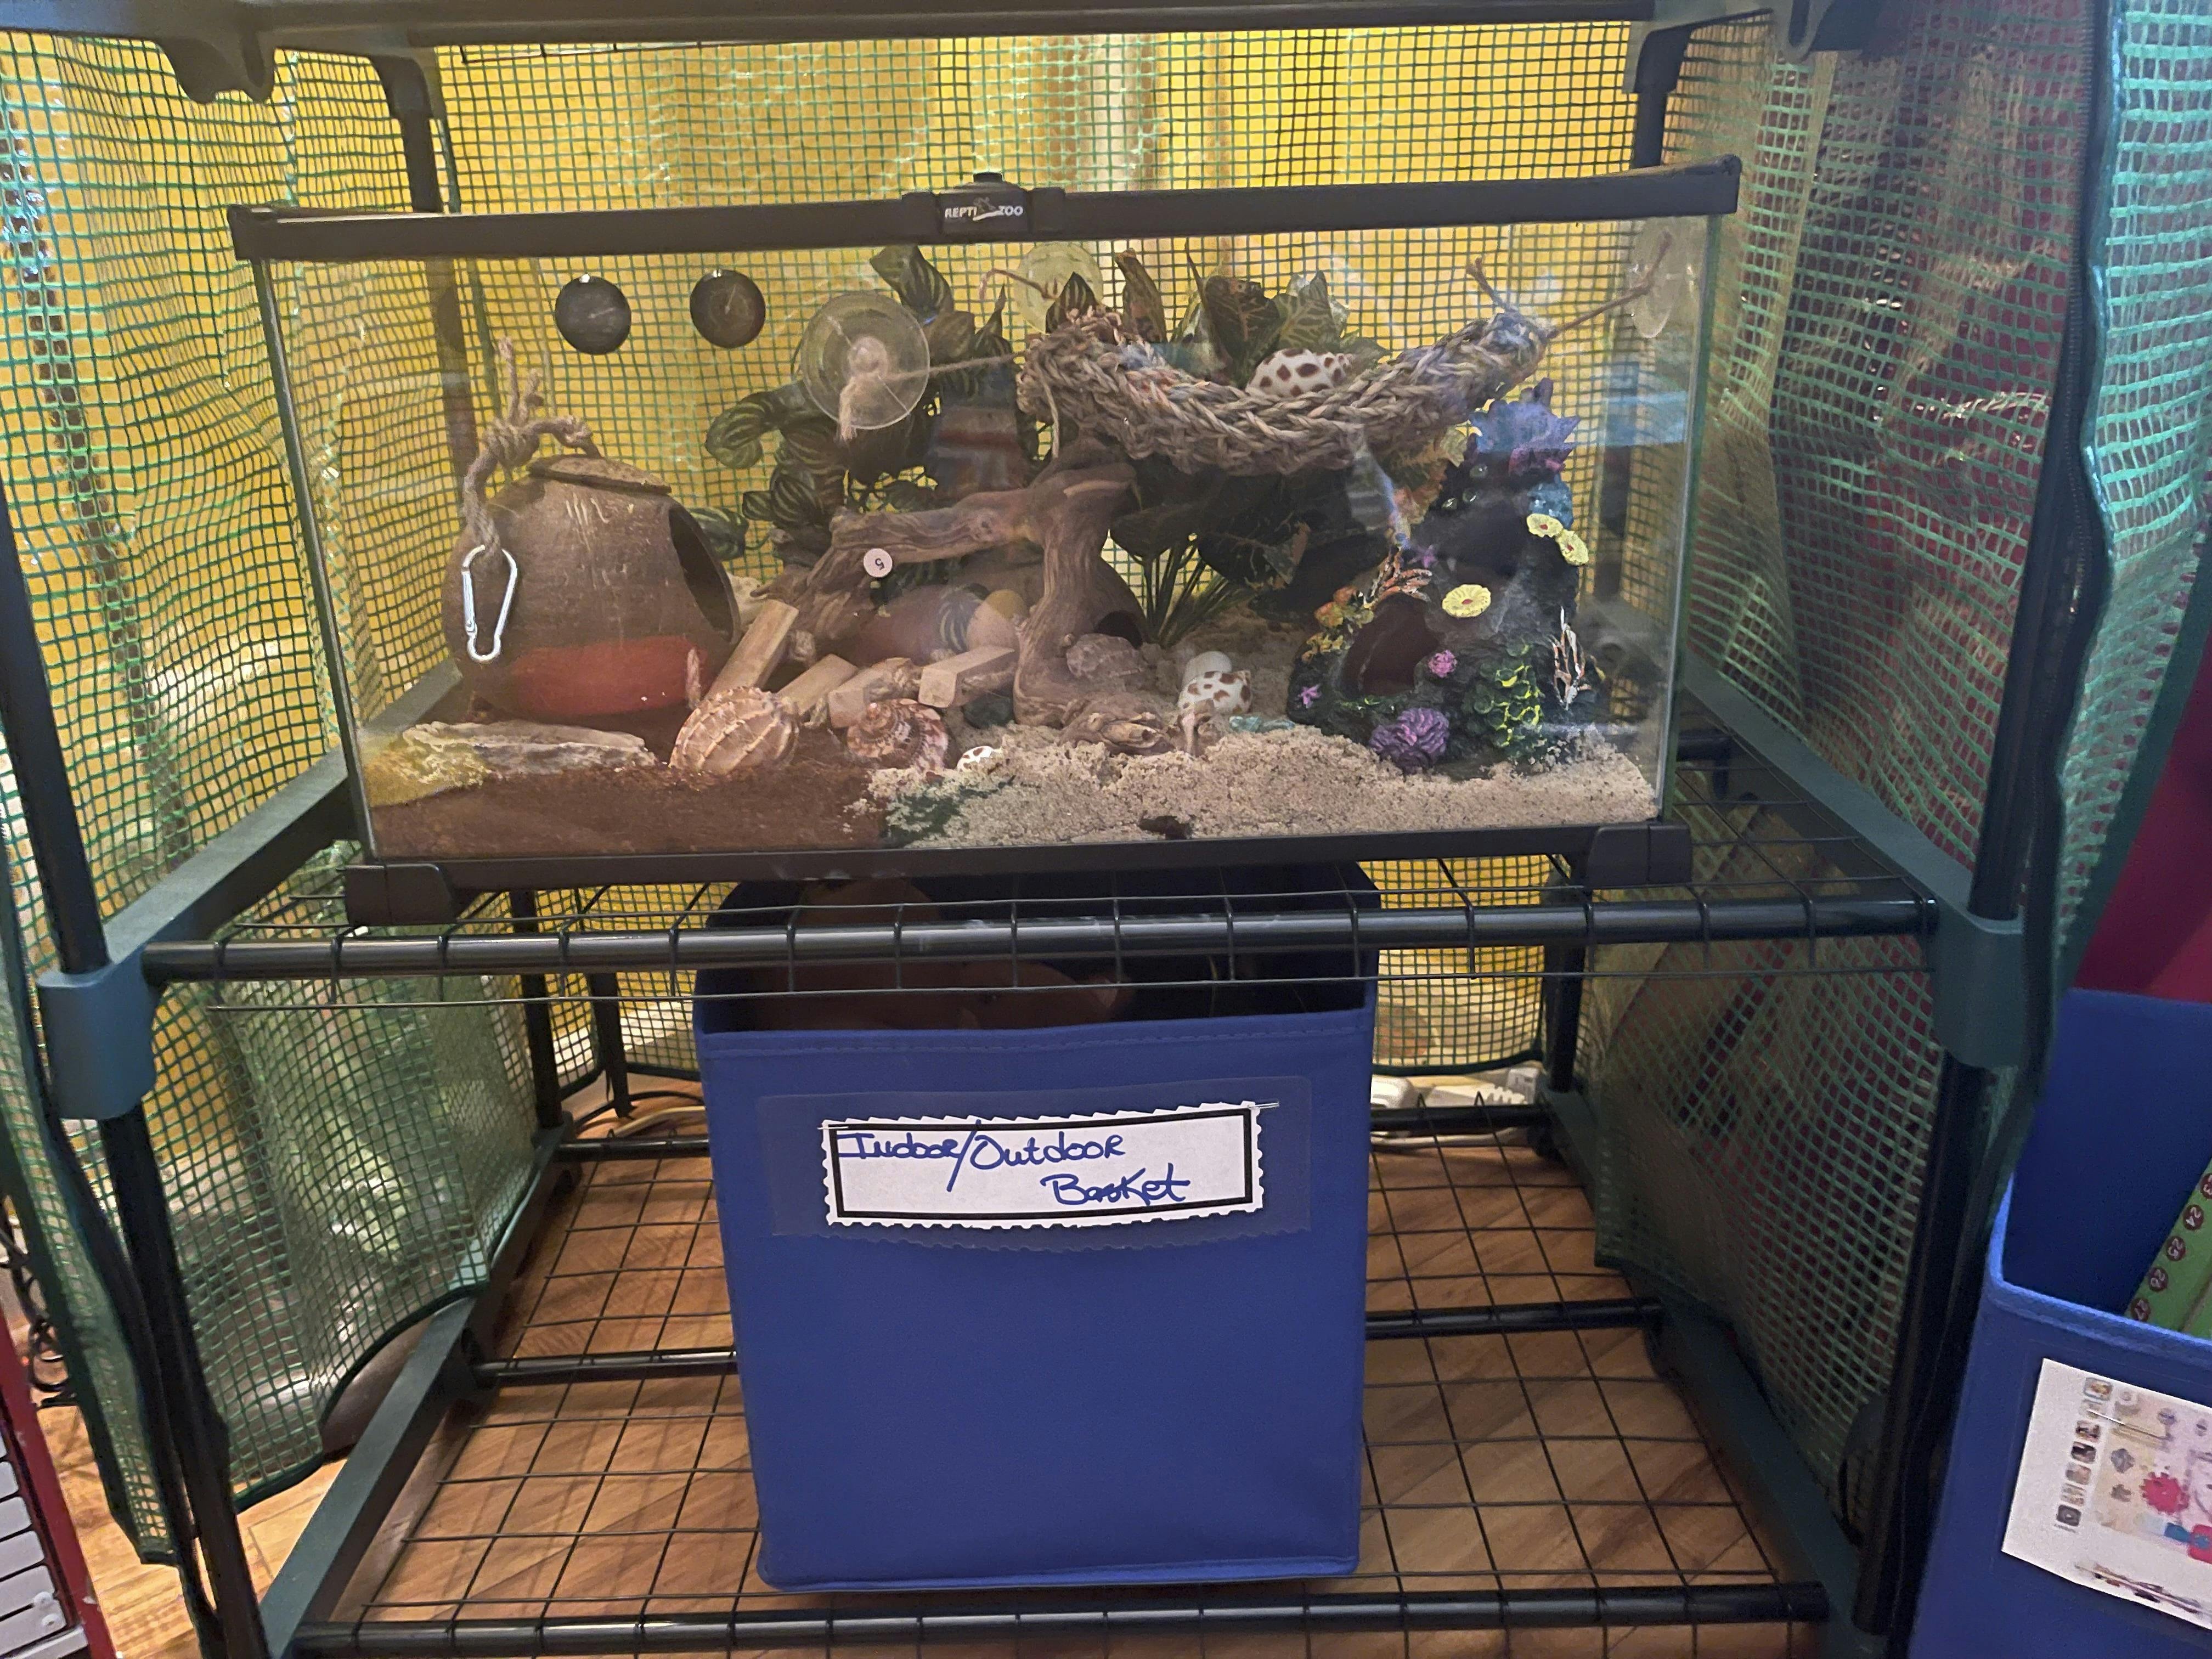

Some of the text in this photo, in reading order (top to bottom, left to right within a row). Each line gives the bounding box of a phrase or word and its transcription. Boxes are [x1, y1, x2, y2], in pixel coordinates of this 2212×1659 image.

[945, 206, 1023, 218] REPTI ZOO
[2185, 1206, 2202, 1227] 24
